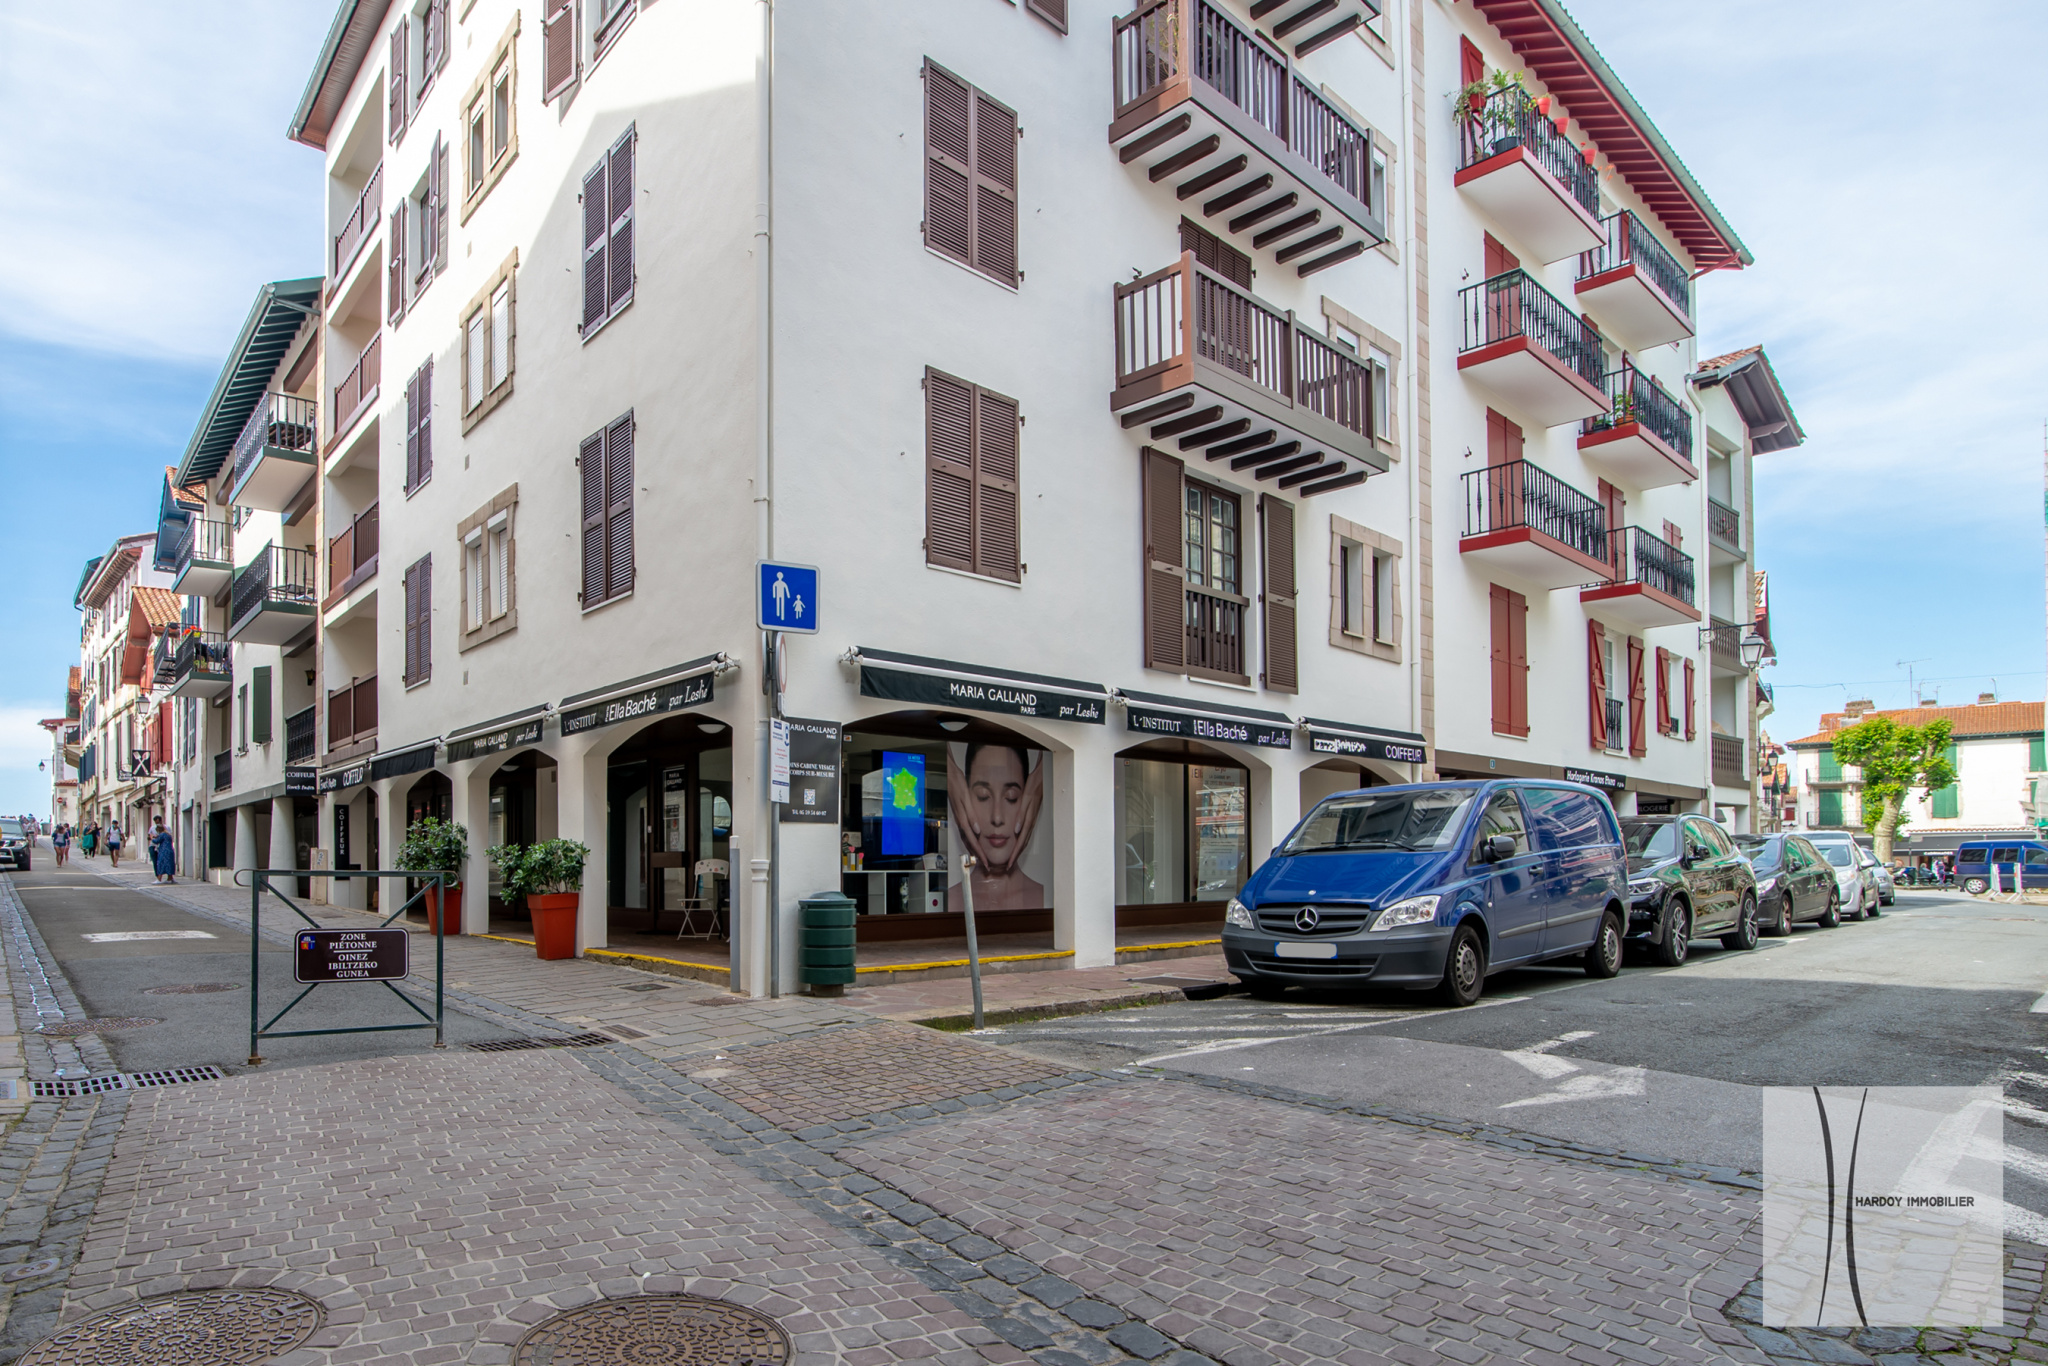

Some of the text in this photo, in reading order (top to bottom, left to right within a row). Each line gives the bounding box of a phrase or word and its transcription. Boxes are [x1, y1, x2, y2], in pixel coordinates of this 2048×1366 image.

[609, 703, 625, 722] Ella
[626, 691, 657, 717] Baché
[668, 694, 683, 711] par
[684, 679, 708, 703] Leslie
[950, 683, 1099, 719] MARIA GALLAND par Leslie
[1020, 706, 1036, 715] PARIS
[790, 723, 805, 732] ARIA
[807, 725, 837, 734] GALLAND
[1133, 715, 1181, 732] L'INSTITUT
[1198, 720, 1214, 737] Ella
[1216, 723, 1248, 741] Baché
[1257, 734, 1270, 745] par
[1271, 731, 1290, 746] Leslie
[474, 737, 487, 749] MARIA
[488, 732, 508, 747] GALLAND
[515, 733, 525, 745] par
[1385, 745, 1423, 762] COIFFEUR
[343, 767, 363, 786] COIFFEUR
[1566, 769, 1590, 784] Horlogerie
[1638, 804, 1668, 812] LOGERIE
[329, 940, 377, 949] PIÉTONNE
[338, 953, 368, 961] OINEZ
[328, 961, 378, 970] IBILTZEKO
